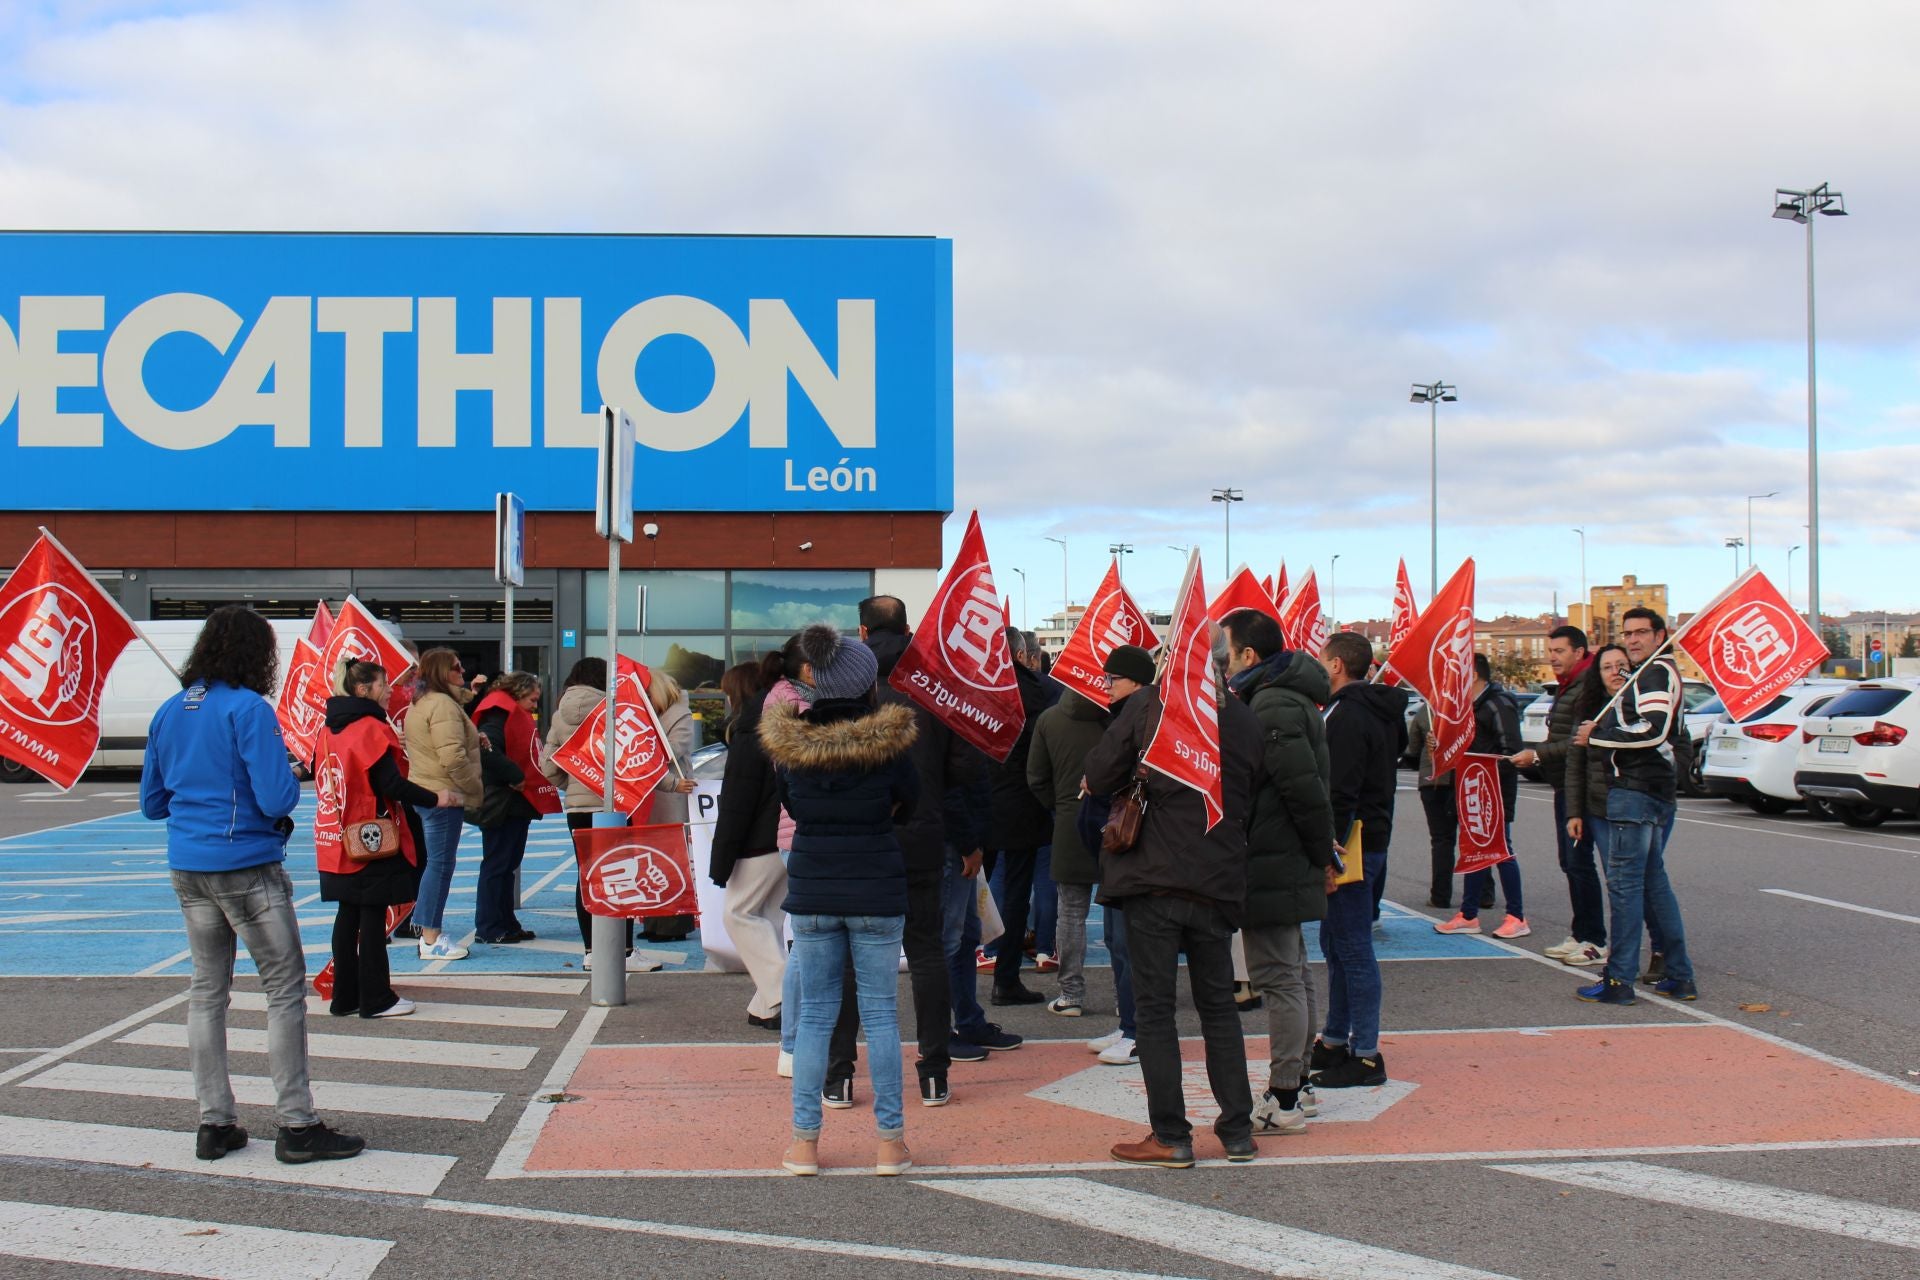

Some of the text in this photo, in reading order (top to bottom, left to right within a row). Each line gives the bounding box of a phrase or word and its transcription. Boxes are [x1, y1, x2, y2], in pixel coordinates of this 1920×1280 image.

[0, 292, 876, 452] ECATHLON
[785, 458, 877, 492] León
[0, 591, 71, 701] UGT
[1731, 606, 1791, 670] UGT
[1464, 777, 1485, 836] UGT
